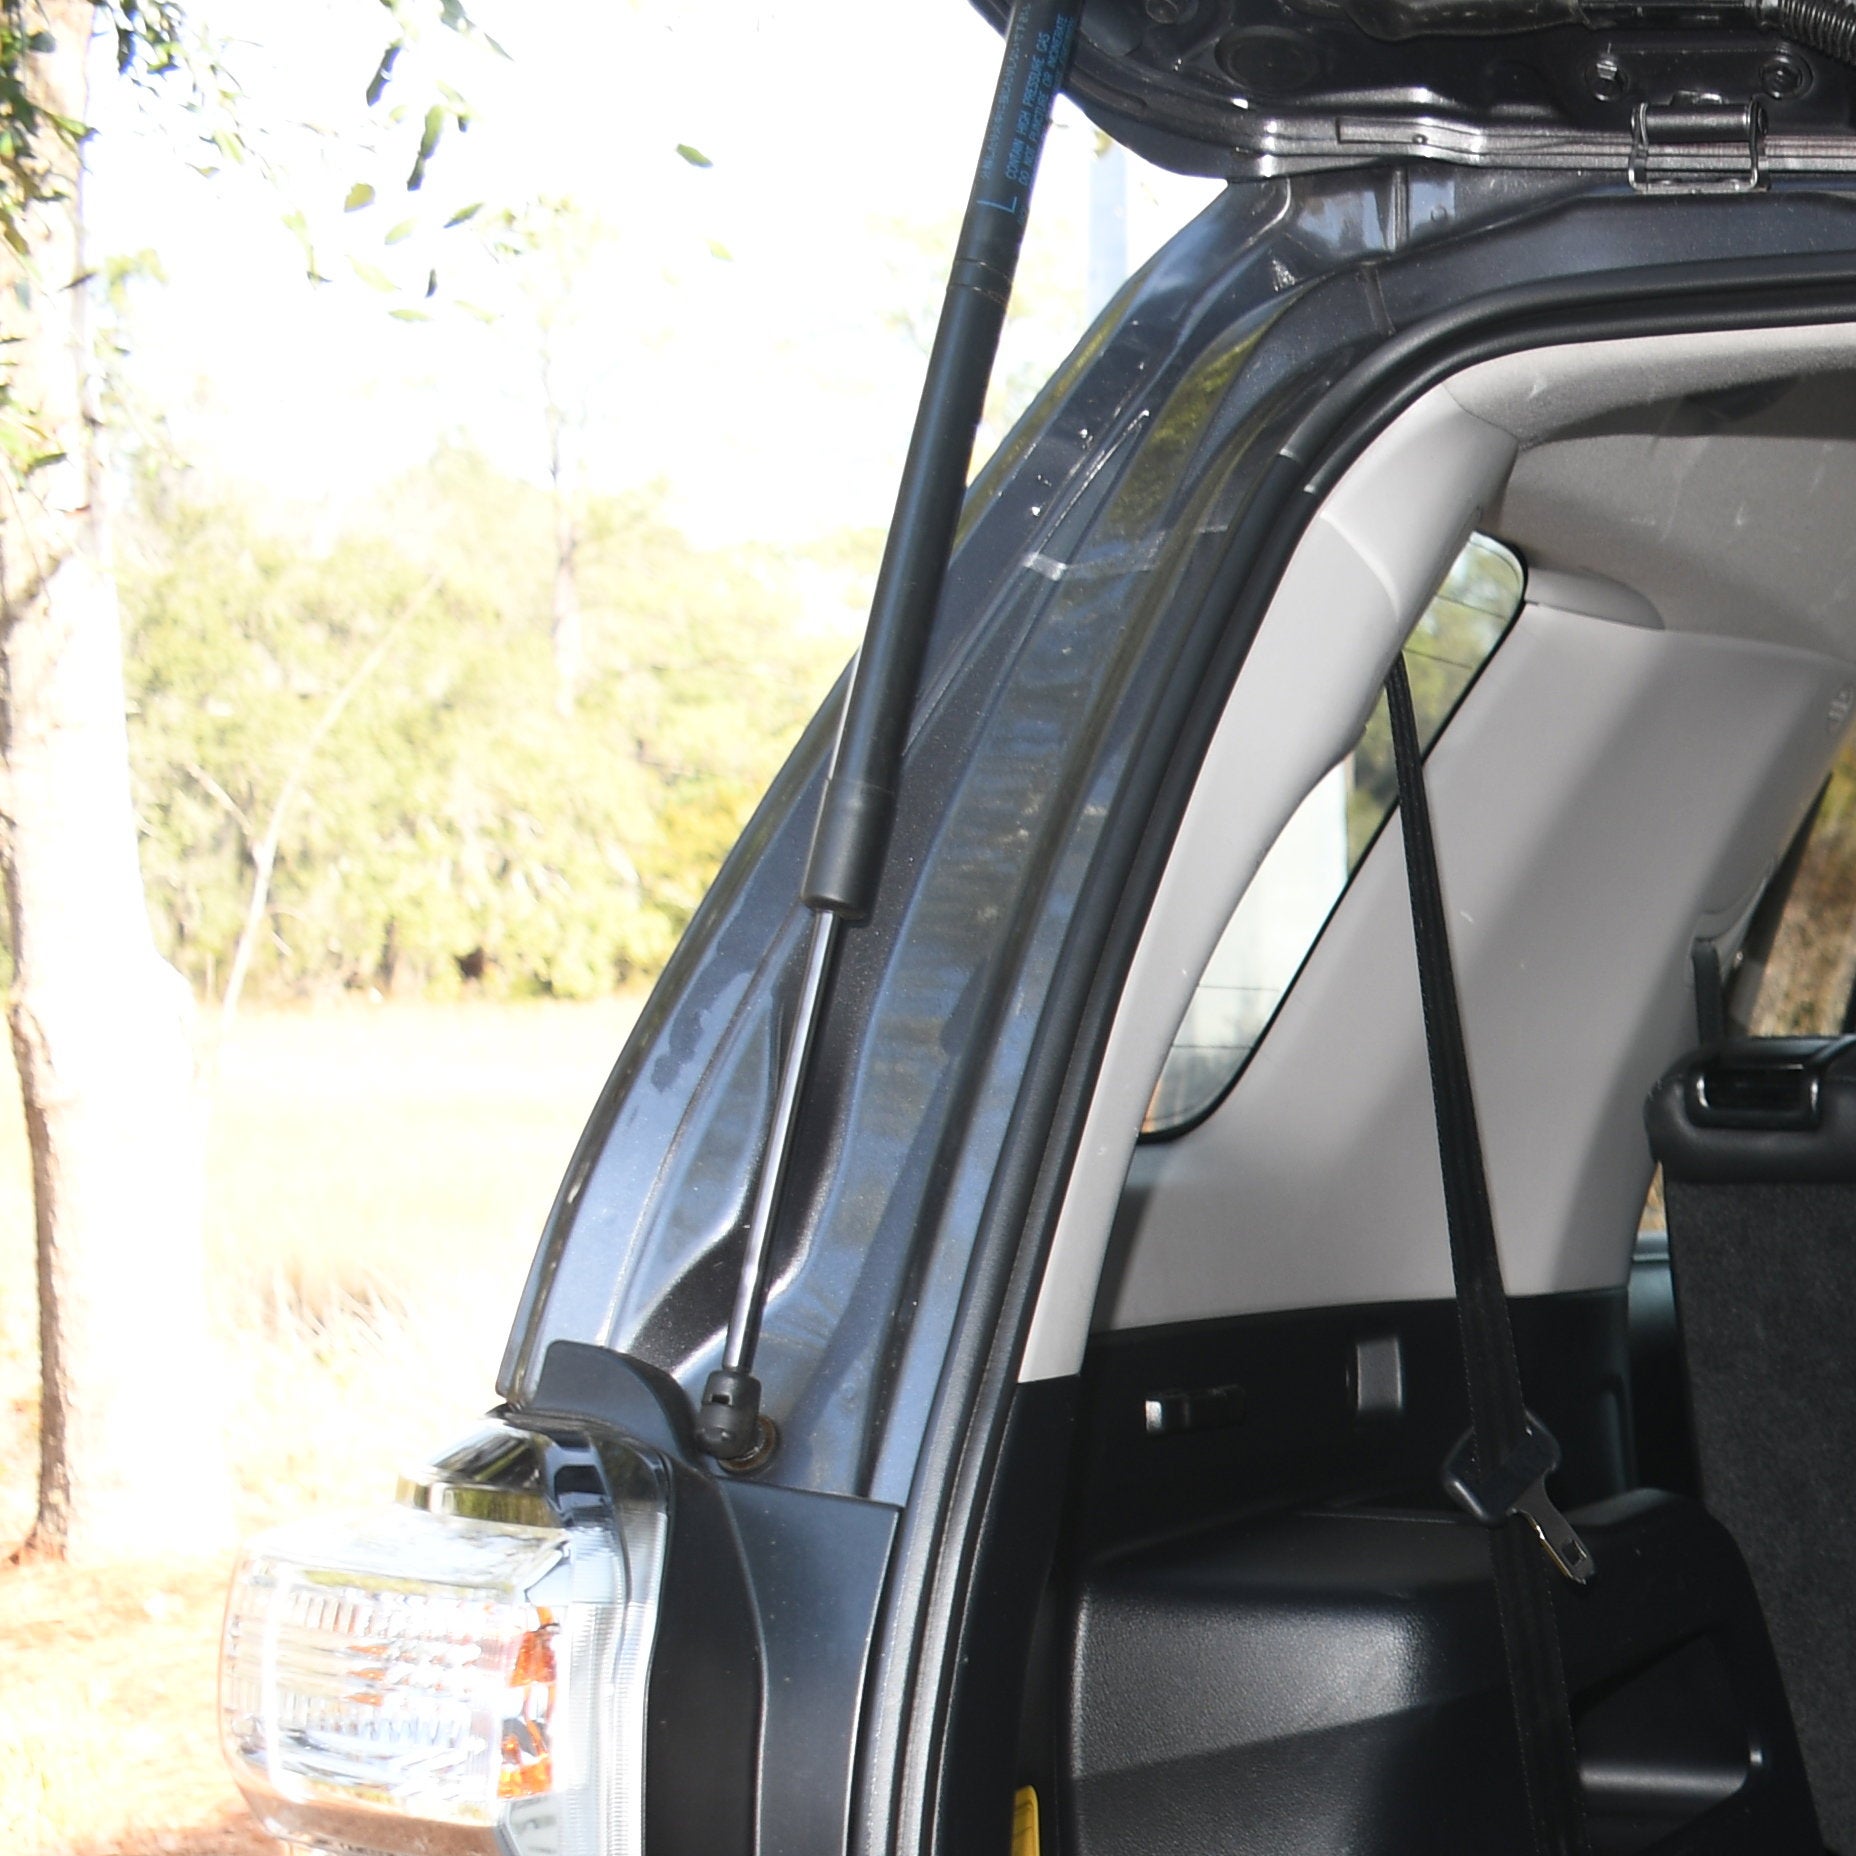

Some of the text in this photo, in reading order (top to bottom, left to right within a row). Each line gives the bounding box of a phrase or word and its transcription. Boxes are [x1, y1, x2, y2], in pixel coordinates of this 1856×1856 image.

[1035, 31, 1050, 52] GAS
[1022, 54, 1045, 107] PRESSURE
[1042, 71, 1053, 87] OR
[1016, 110, 1031, 136] HIGH
[1028, 90, 1049, 142] PUNCTURE
[1005, 138, 1025, 180] CONTAIN
[1024, 143, 1036, 167] NOT
[1018, 168, 1030, 186] DO
[976, 195, 1018, 215] L
